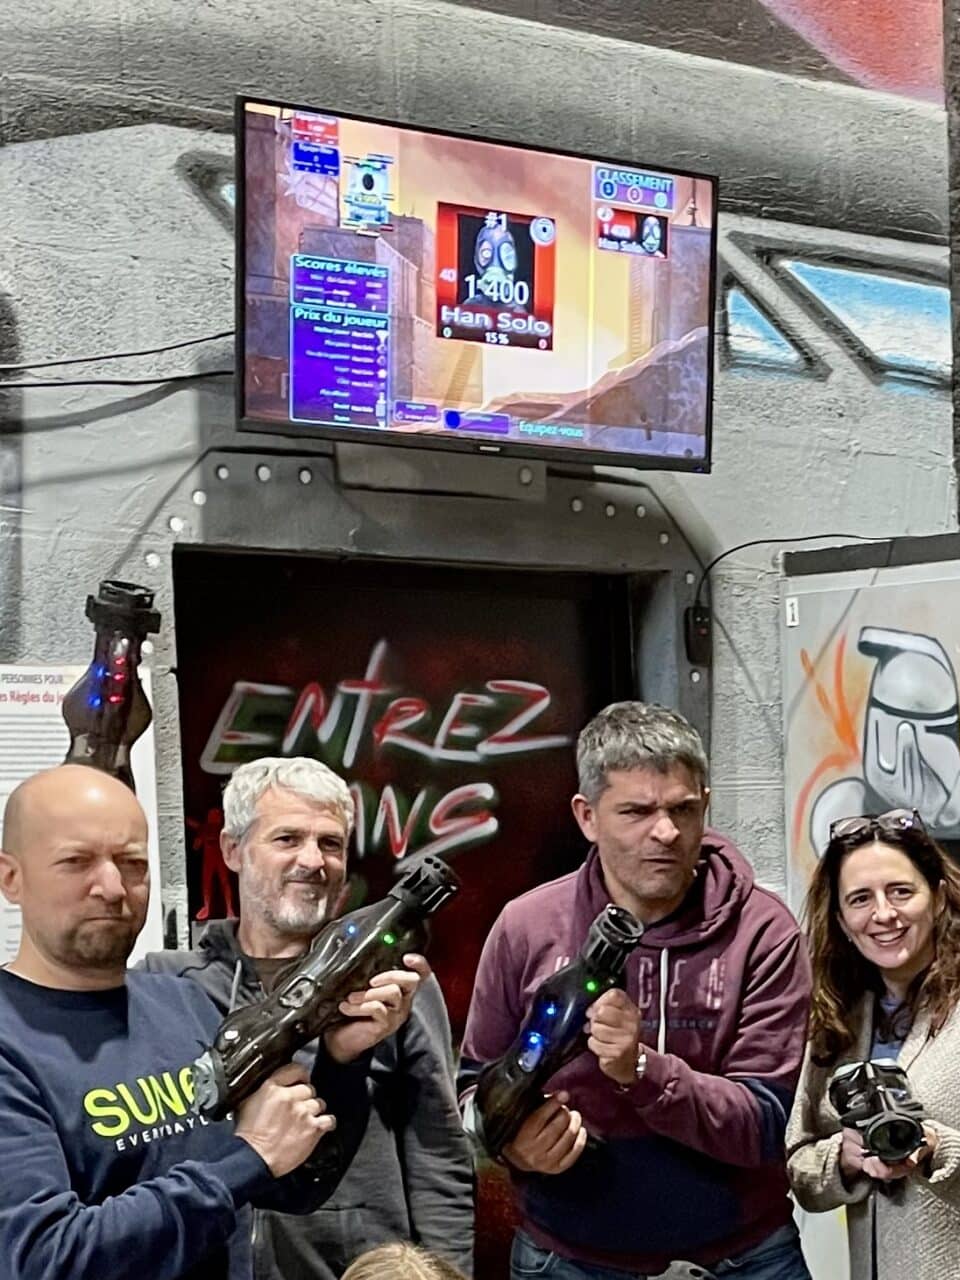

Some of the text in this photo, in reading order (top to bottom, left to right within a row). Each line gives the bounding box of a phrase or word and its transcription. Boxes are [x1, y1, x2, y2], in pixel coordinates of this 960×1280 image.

[596, 169, 673, 192] CLASSEMENT
[485, 212, 507, 233] #1
[296, 257, 342, 273] Scores
[294, 308, 387, 329] Prix du joueur
[441, 305, 551, 335] Han Solo
[485, 332, 509, 345] 15%
[9, 690, 41, 705] Règles
[42, 690, 55, 703] du
[198, 637, 573, 775] ENTREZ
